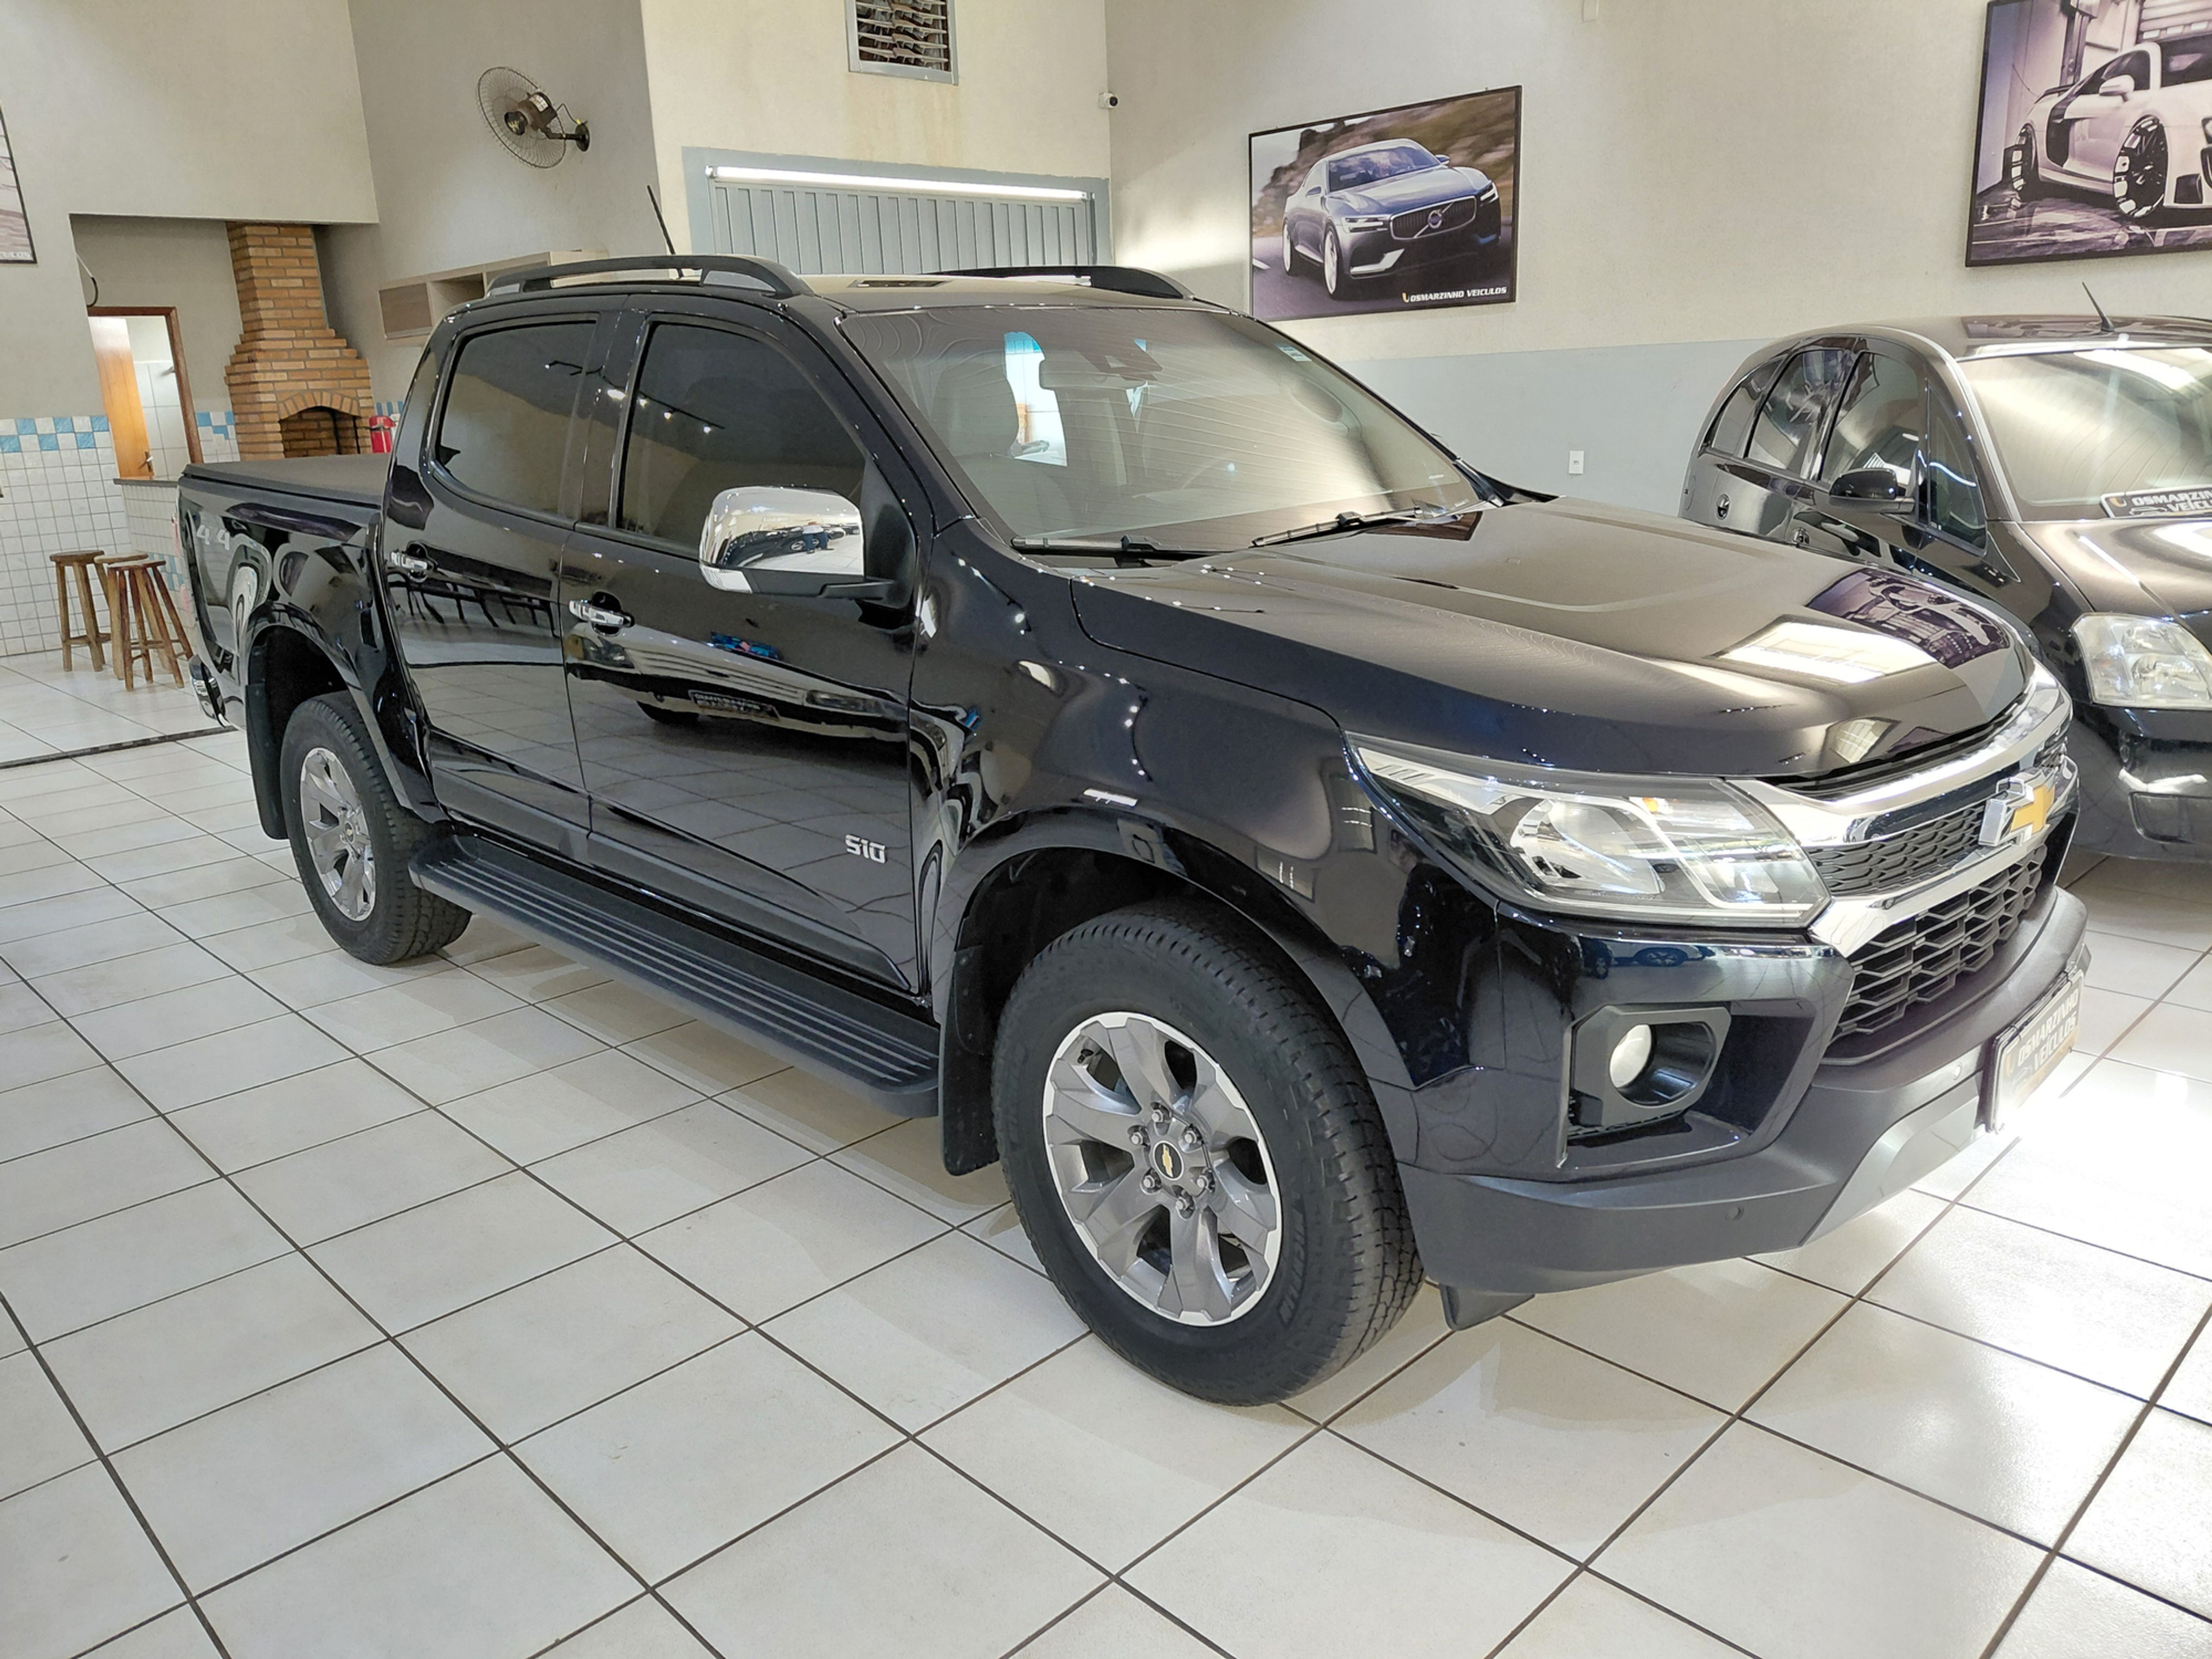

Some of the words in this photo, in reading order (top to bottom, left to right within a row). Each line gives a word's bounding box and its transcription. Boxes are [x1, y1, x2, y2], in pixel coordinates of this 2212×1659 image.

[1410, 290, 1464, 302] OSMARZINHO
[1466, 286, 1507, 298] VEICULOS
[845, 834, 886, 864] S10
[2017, 988, 2079, 1067] OSMARZINHO
